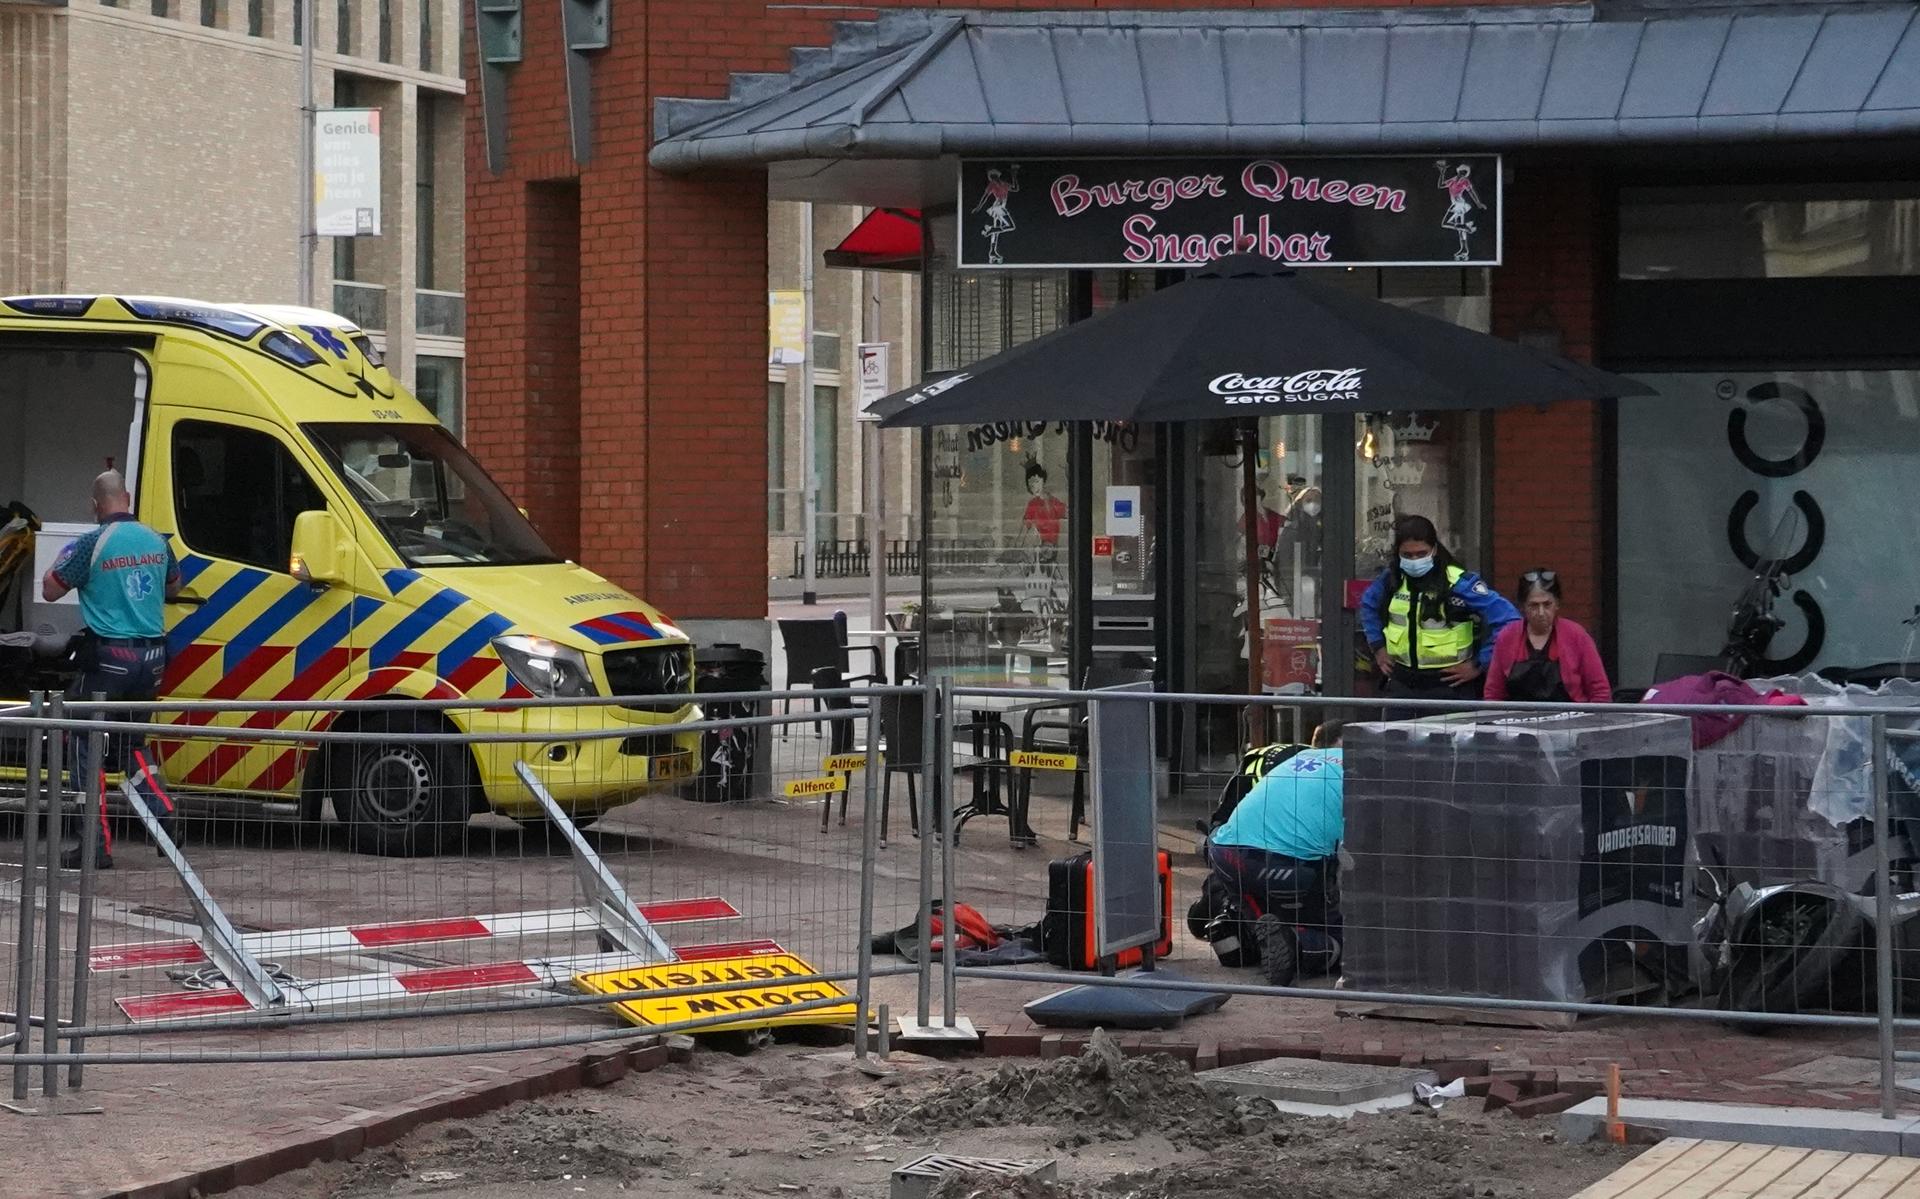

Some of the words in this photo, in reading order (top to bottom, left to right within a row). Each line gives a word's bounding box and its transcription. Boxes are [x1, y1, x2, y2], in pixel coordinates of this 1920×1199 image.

[1050, 173, 1227, 217] Burger
[1241, 159, 1407, 213] Queen
[1208, 368, 1367, 395] Coca-Cola
[1224, 395, 1281, 404] zero
[1284, 391, 1360, 403] SUGAR
[829, 757, 868, 770] Allfenc
[1018, 754, 1065, 768] Allfence
[792, 780, 836, 795] Allfence
[1598, 824, 1677, 855] VANDERSANDEN
[609, 963, 802, 992] terrein
